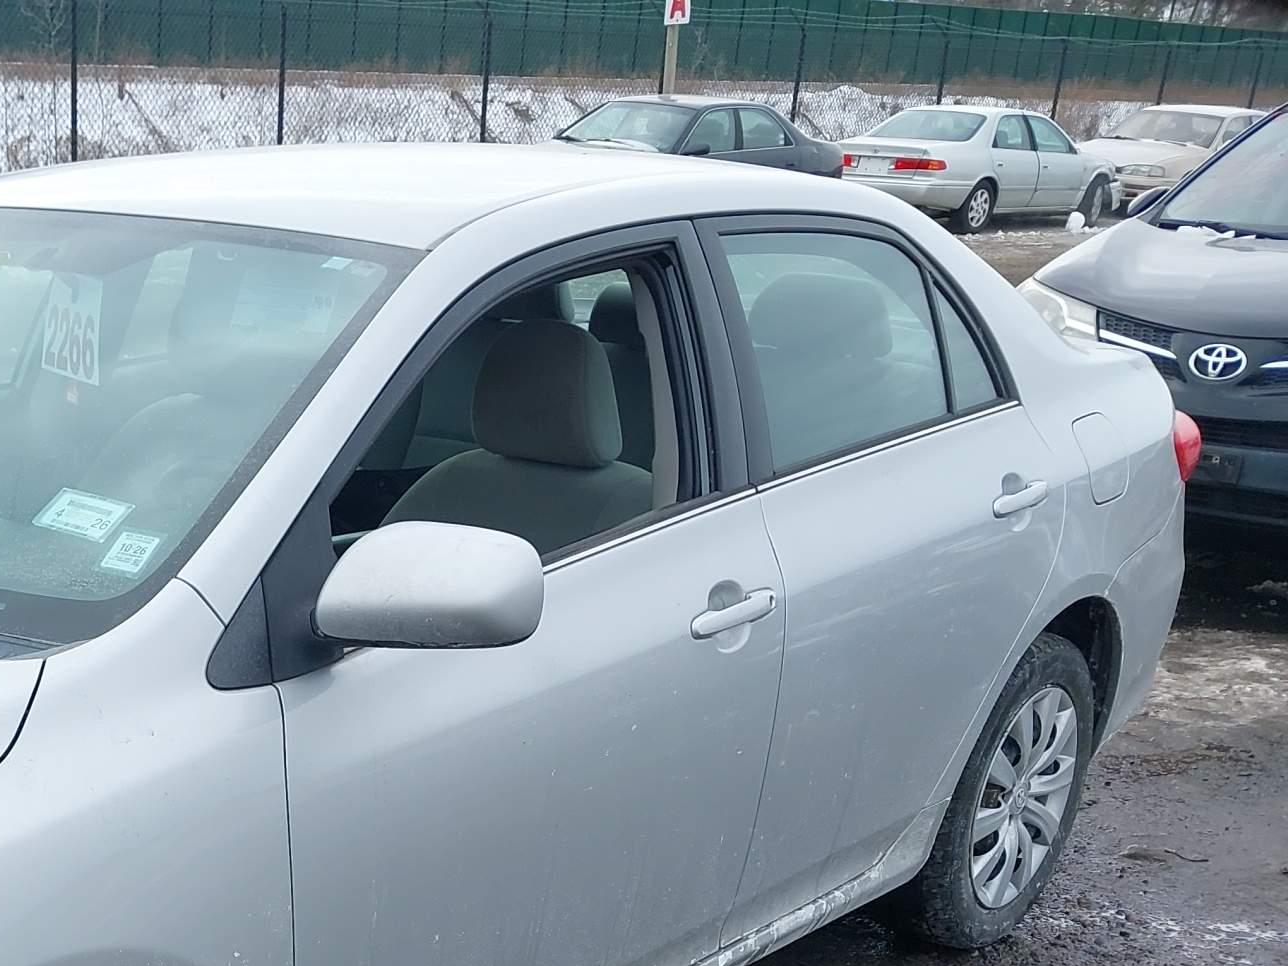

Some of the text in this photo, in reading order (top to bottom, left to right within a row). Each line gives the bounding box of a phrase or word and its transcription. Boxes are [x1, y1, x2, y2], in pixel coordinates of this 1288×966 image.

[669, 0, 686, 19] A
[44, 303, 95, 380] 2266
[90, 518, 111, 531] 26
